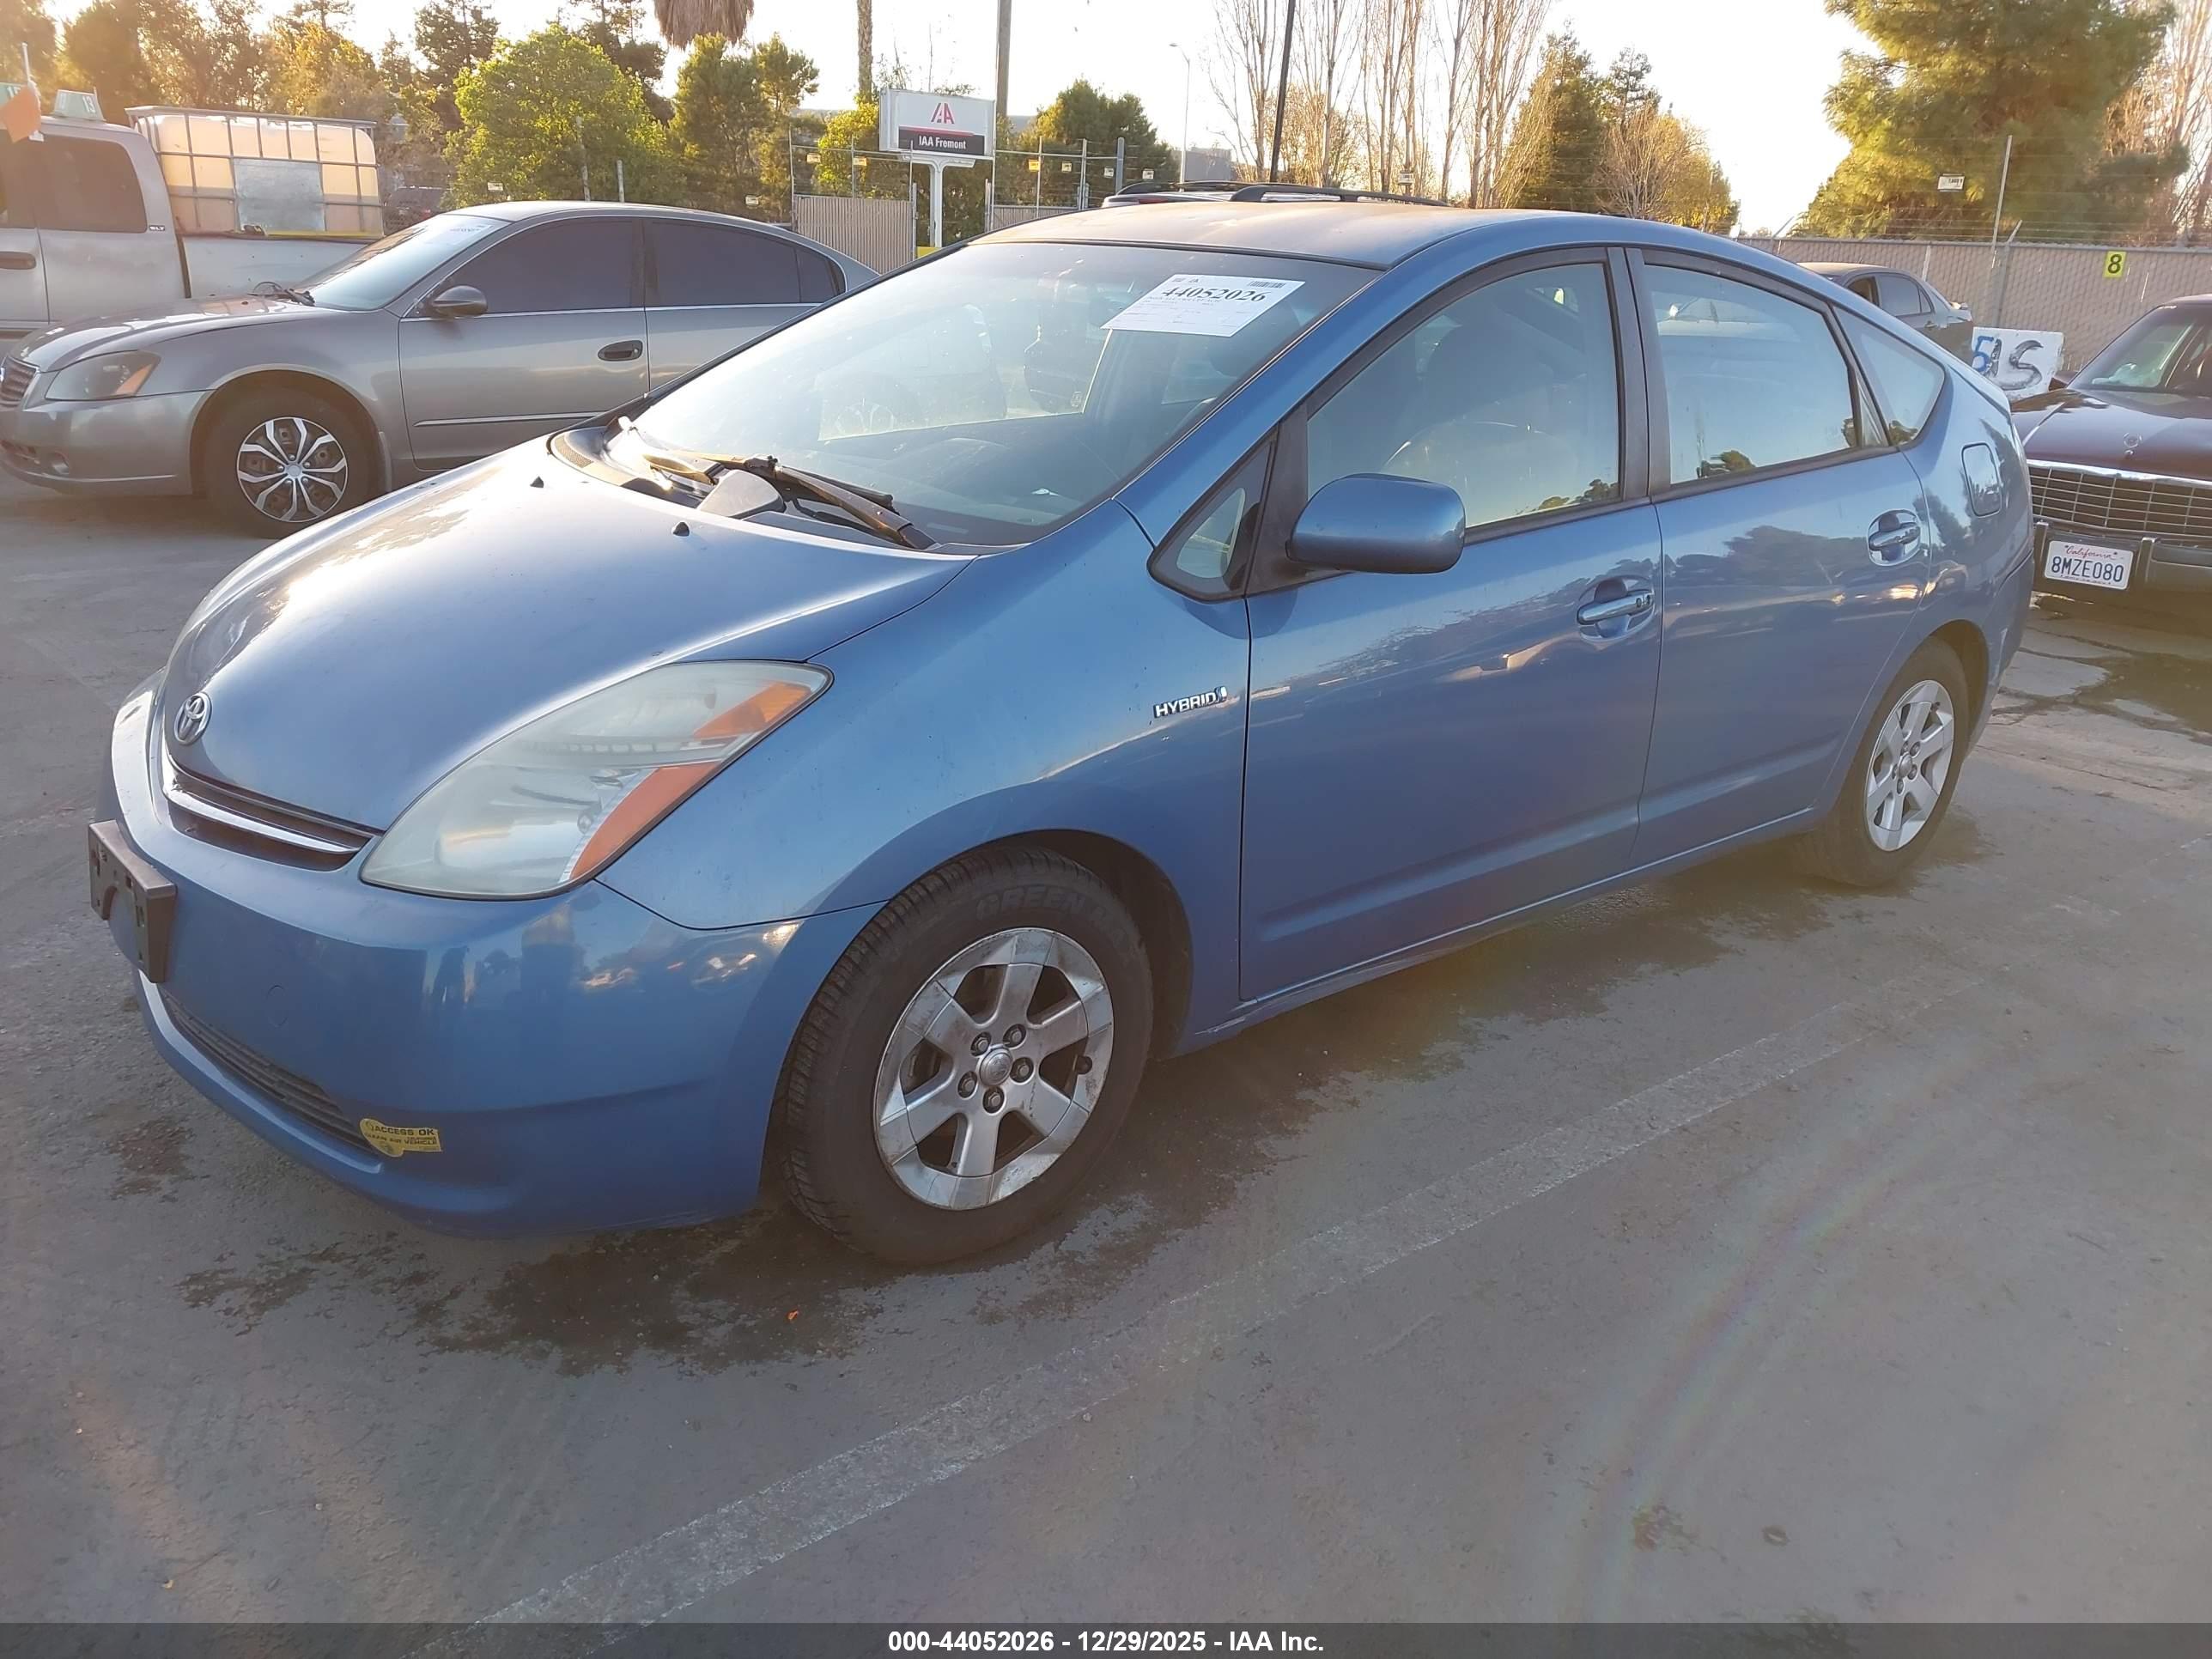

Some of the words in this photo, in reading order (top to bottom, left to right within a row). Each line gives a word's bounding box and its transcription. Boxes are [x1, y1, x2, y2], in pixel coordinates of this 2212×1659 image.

[919, 135, 933, 147] IAA
[935, 137, 966, 149] Fremont
[2107, 254, 2122, 274] 8
[1162, 286, 1271, 302] 44052026
[2066, 545, 2117, 561] California
[2051, 556, 2124, 582] 8MZE080
[1153, 691, 1218, 718] HYBRID
[375, 1125, 414, 1136] ACCESS
